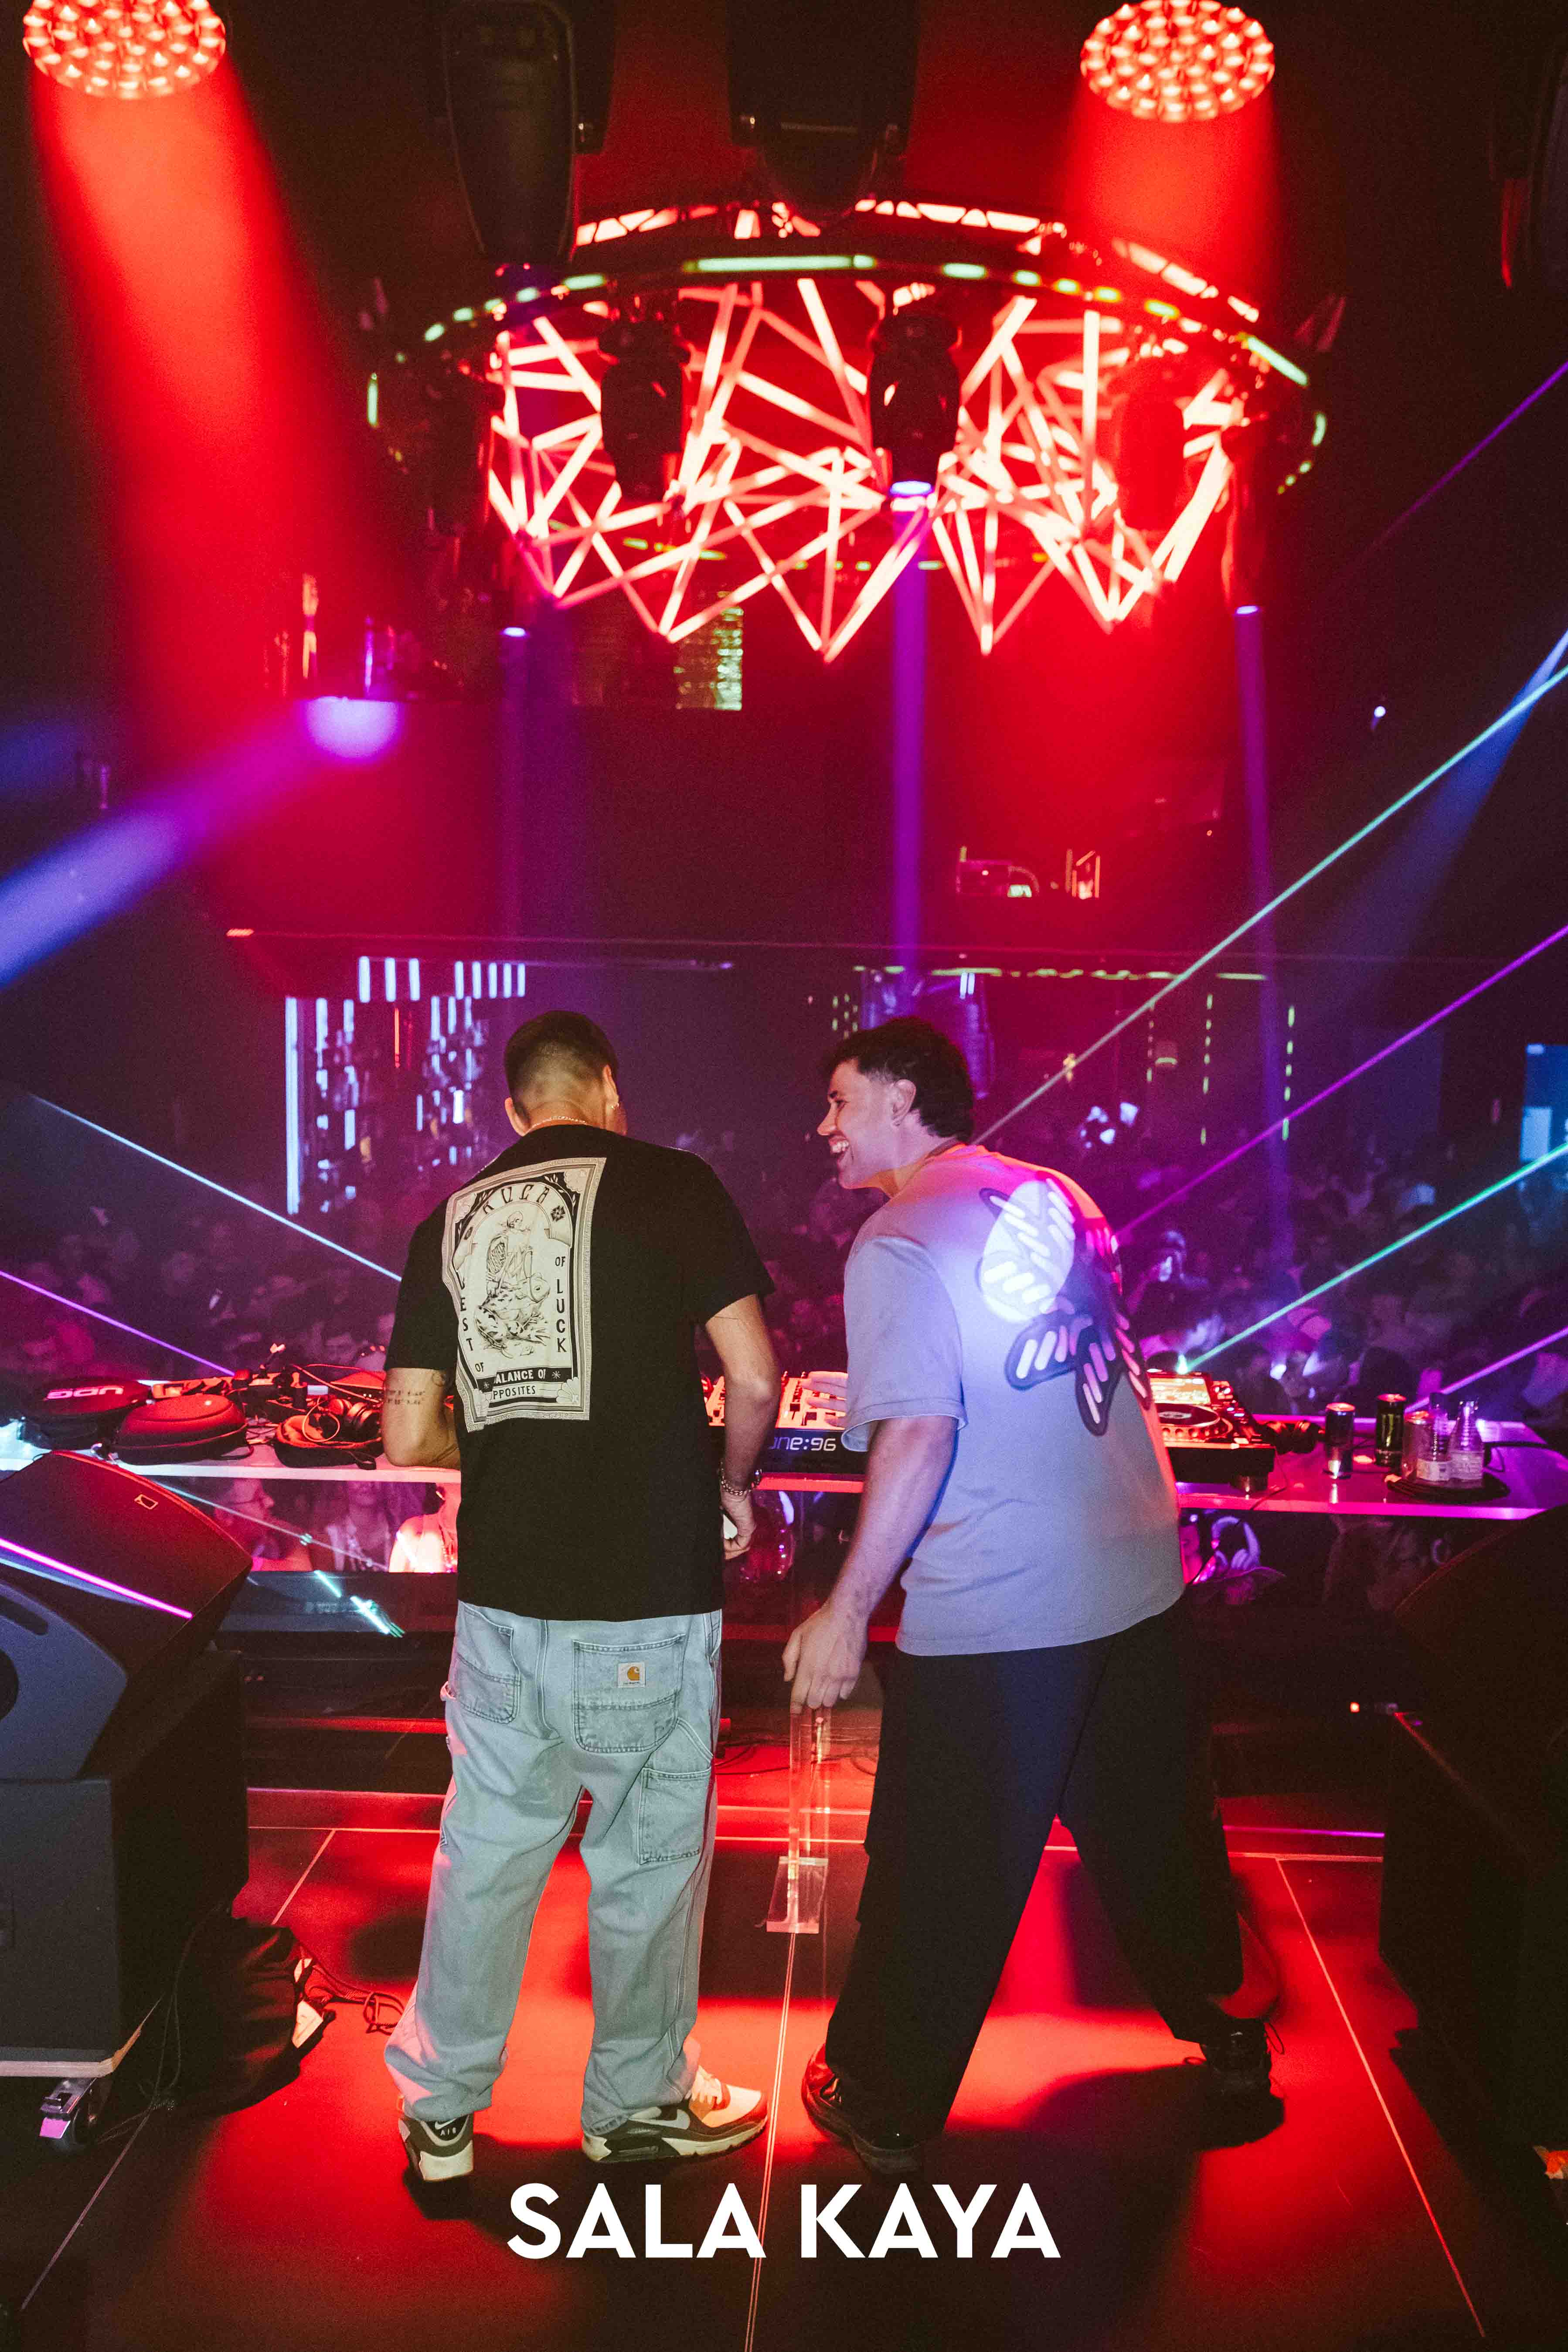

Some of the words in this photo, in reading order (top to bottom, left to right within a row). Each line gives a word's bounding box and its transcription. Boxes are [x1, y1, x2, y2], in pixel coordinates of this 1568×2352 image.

[555, 1256, 565, 1266] OF
[556, 1279, 567, 1352] LUCK
[475, 1362, 484, 1372] OF
[493, 1370, 534, 1384] ALANCE
[493, 1385, 536, 1399] PPOSITES
